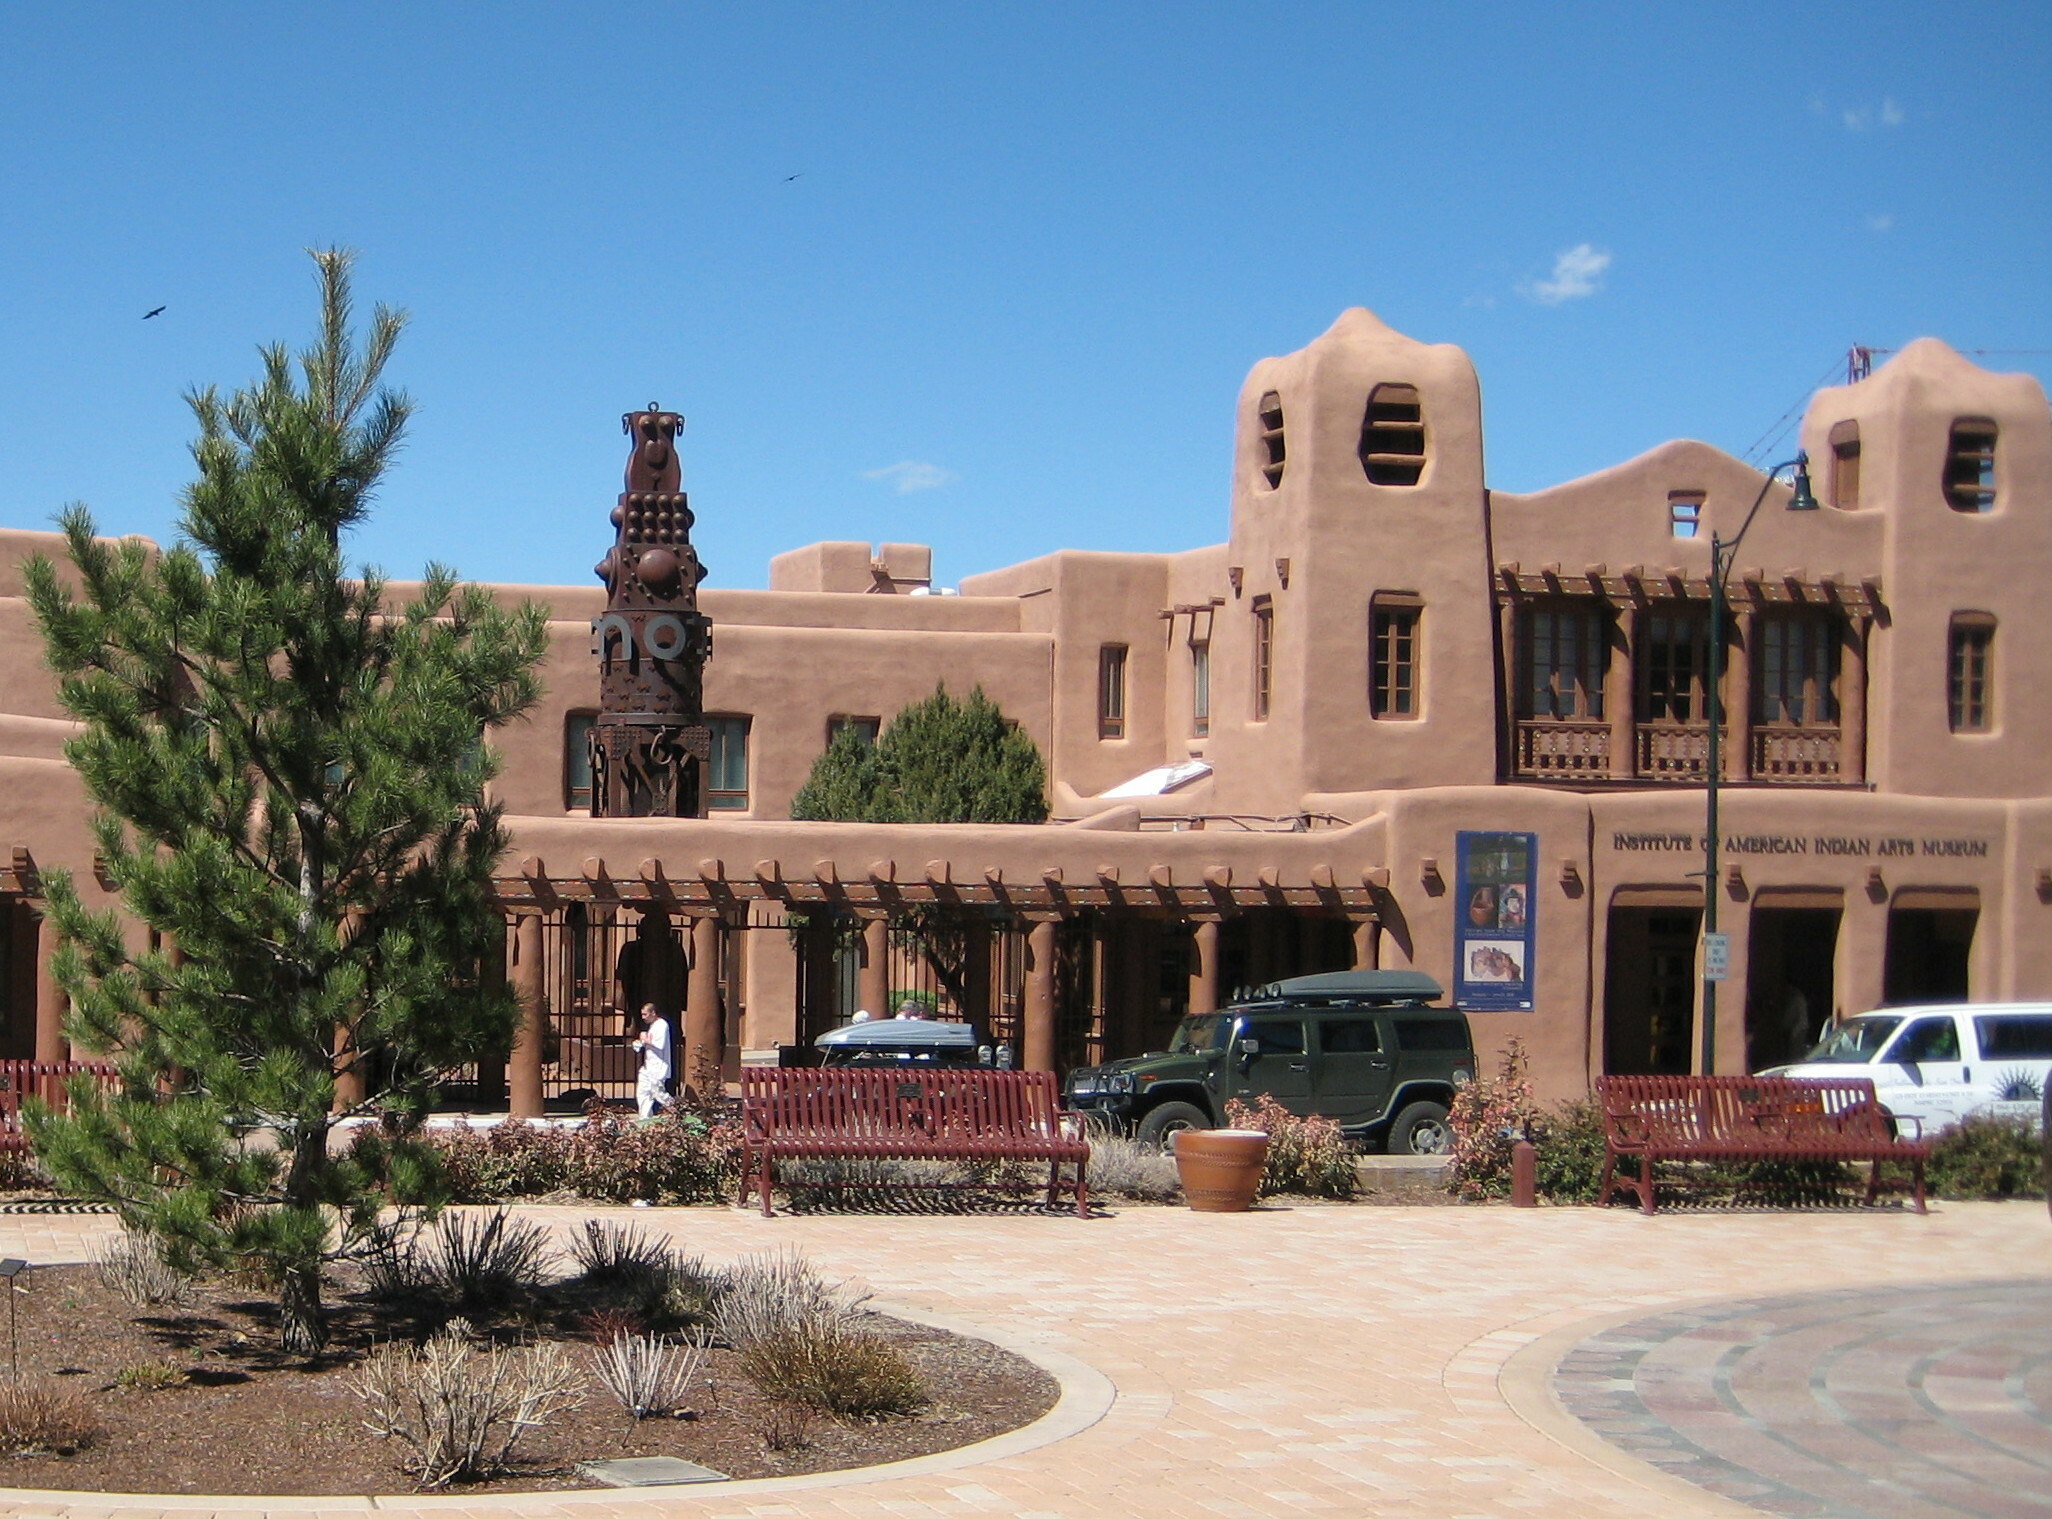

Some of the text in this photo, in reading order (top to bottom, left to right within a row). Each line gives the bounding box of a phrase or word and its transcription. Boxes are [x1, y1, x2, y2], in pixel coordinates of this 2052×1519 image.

[1614, 833, 1988, 857] INSTITUTE O AMERICAN INDIAN ARTS MUSEUM
